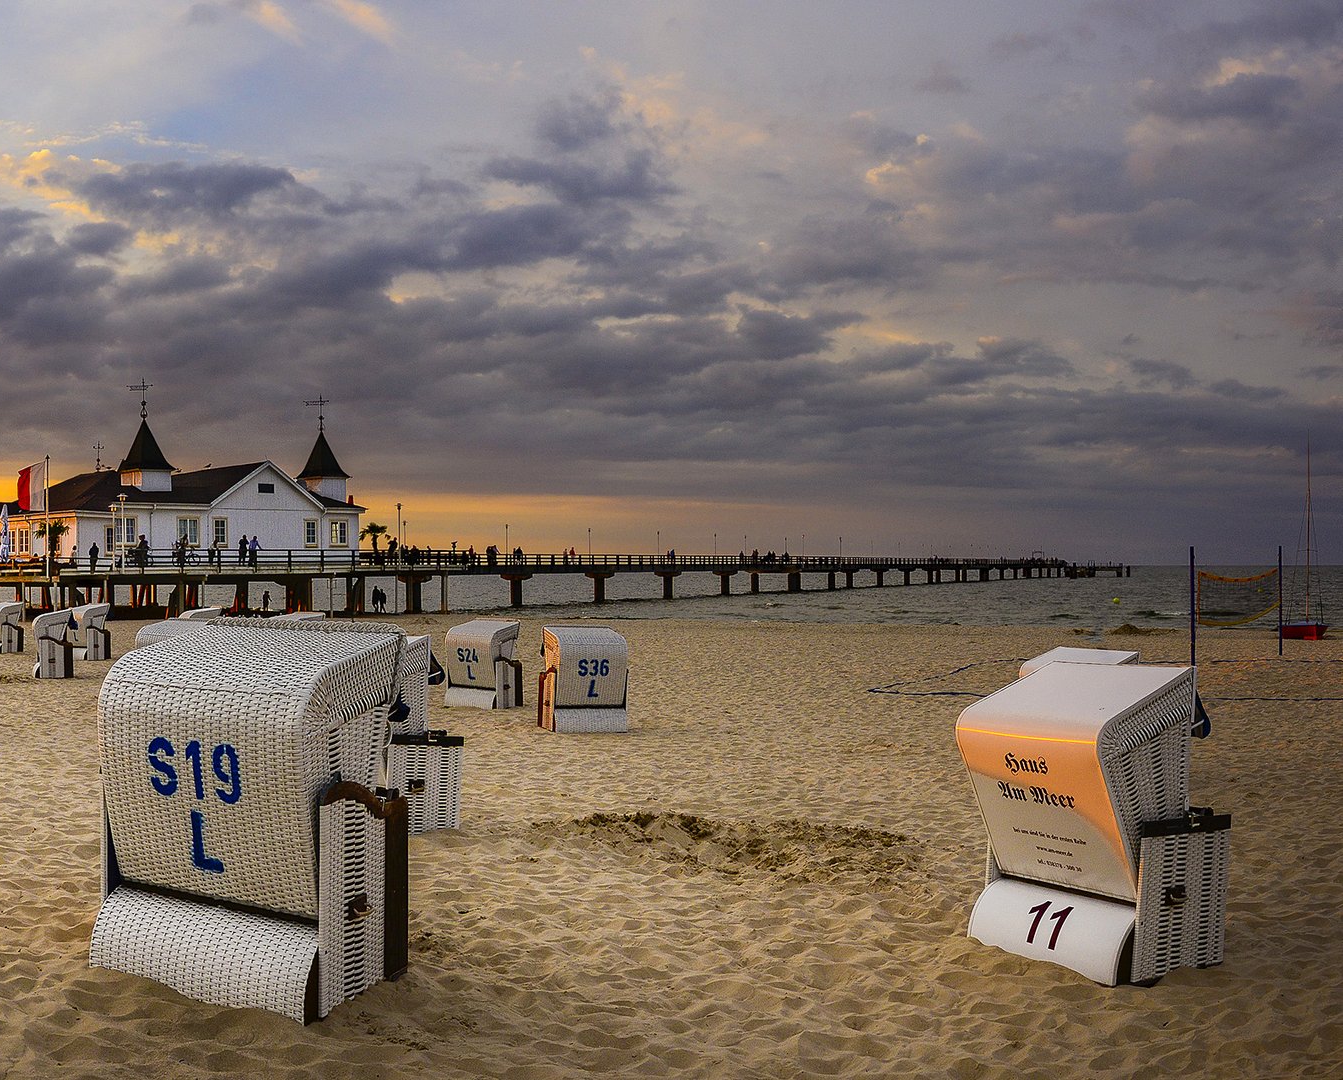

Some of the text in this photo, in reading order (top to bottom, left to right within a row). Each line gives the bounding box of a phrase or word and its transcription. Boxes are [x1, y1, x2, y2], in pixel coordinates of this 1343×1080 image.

[457, 648, 479, 663] S24
[577, 658, 610, 677] S36
[467, 665, 476, 680] L
[587, 679, 599, 698] L
[148, 736, 242, 805] S19
[1004, 752, 1049, 776] Haus
[998, 780, 1076, 809] Am Meer
[190, 808, 225, 874] L
[1026, 900, 1075, 951] 11
